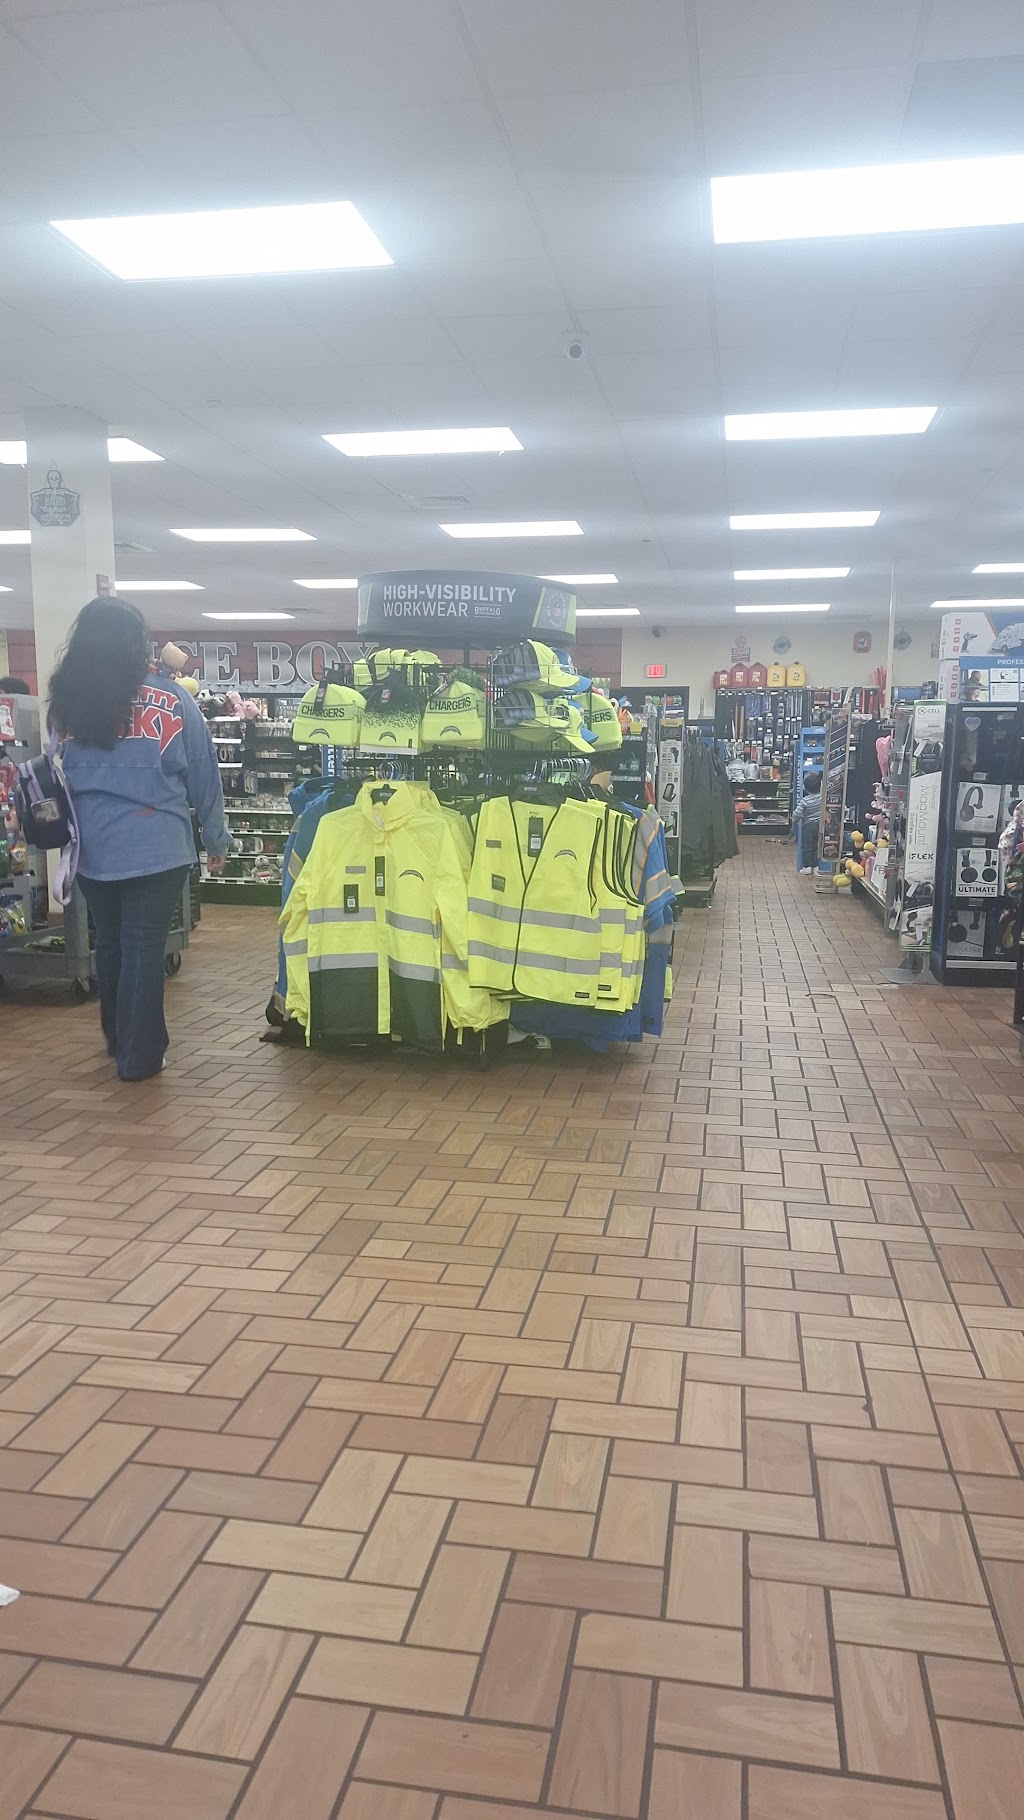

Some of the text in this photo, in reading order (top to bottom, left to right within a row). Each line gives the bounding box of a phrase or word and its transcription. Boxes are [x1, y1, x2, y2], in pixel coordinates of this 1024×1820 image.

[383, 584, 517, 603] HIGH-VISIBILITY
[383, 601, 468, 617] WORKWEAR
[474, 606, 501, 616] BUFFALO
[429, 696, 472, 711] CHARGERS
